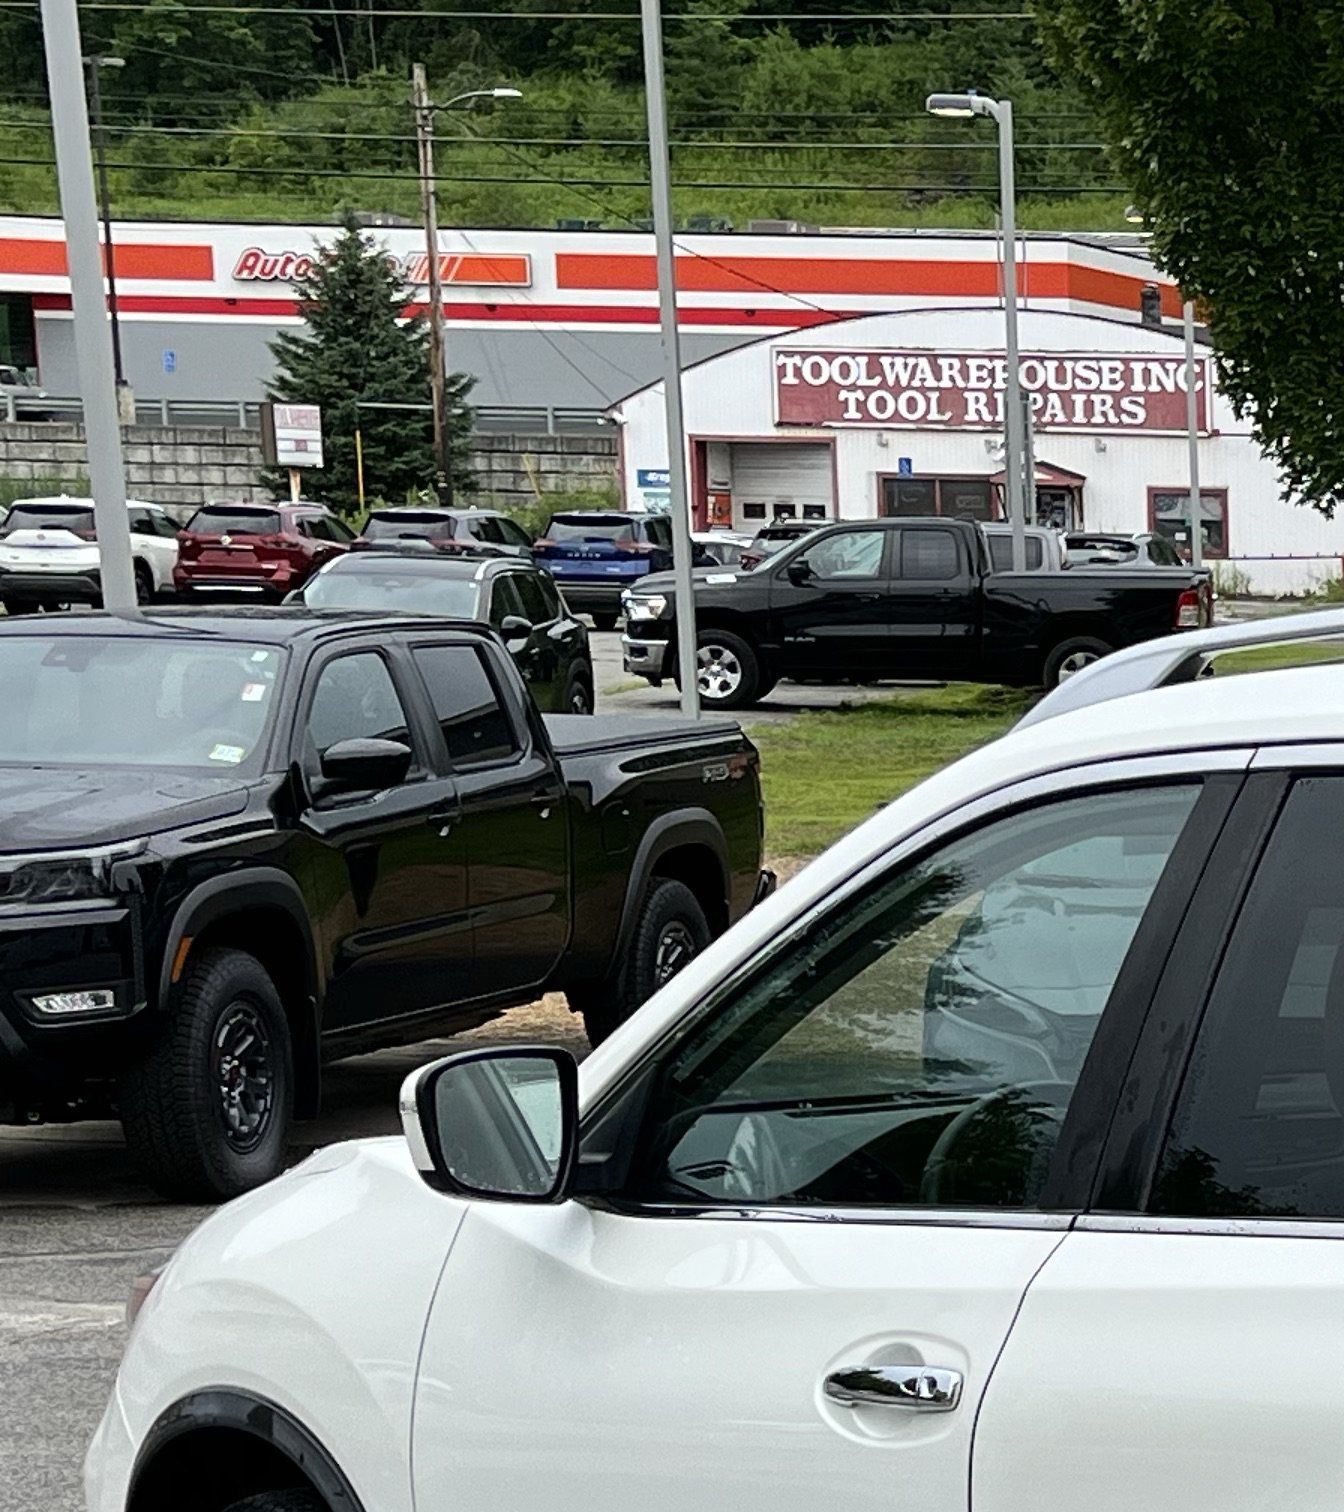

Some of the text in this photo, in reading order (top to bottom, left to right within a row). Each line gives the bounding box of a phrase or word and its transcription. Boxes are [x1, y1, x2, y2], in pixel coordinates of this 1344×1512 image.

[777, 354, 882, 387] TOOL
[1129, 361, 1203, 392] INC
[838, 389, 952, 421] TOOL
